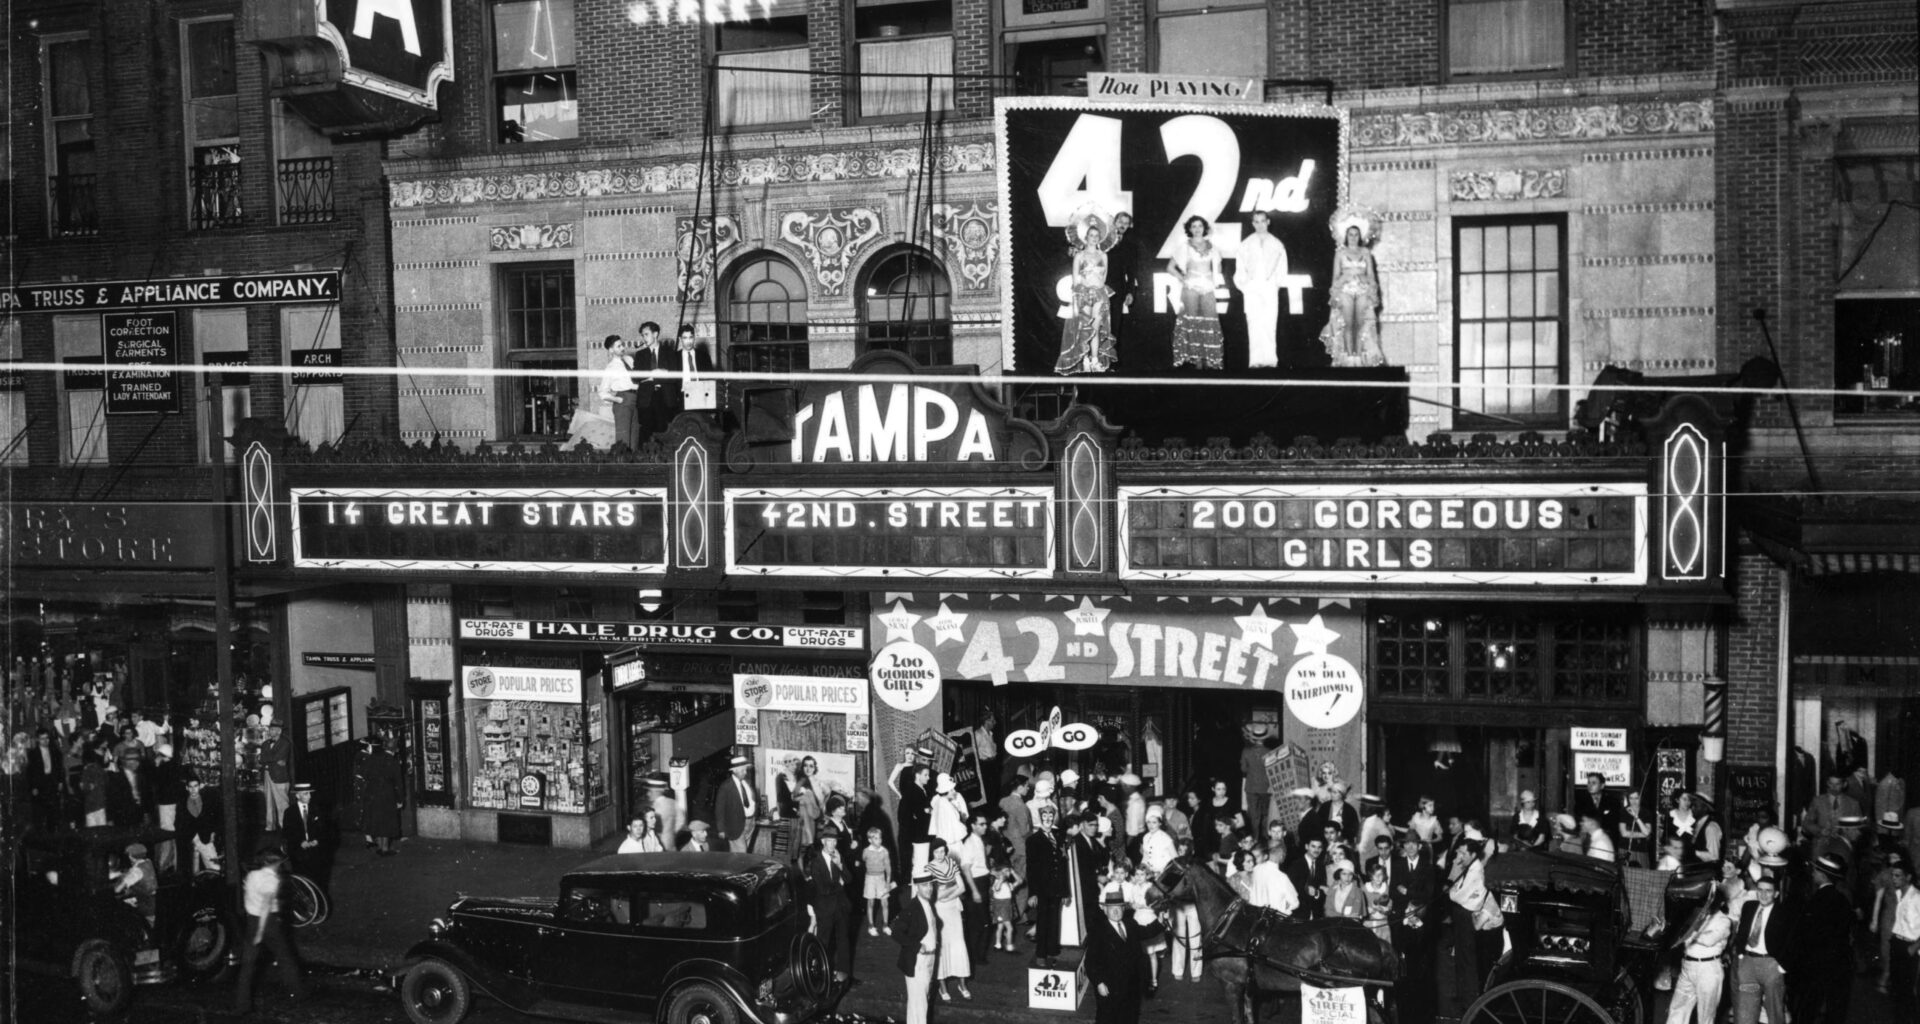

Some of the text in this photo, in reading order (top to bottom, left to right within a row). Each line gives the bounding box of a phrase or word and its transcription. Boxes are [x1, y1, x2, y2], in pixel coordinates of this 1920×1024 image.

[30, 288, 86, 308] TRUSS
[120, 282, 221, 304] APPLIANCE
[126, 318, 153, 327] FOOT
[110, 326, 170, 337] CORRECTION
[117, 339, 162, 349] SURGICAL
[115, 348, 167, 358] GARMENTS
[303, 353, 332, 365] ARCH
[111, 369, 171, 380] EXAMINATION
[120, 382, 162, 393] TRAINED
[112, 392, 130, 401] LADY
[326, 501, 635, 527] 14 GREAT STARS
[1192, 500, 1564, 530] 200 GORGEOUS
[1283, 538, 1434, 568] GIRLS
[464, 620, 525, 630] CUT-RATE
[535, 621, 781, 641] HALE DRUG CO.
[474, 628, 515, 638] DRUGS
[787, 628, 857, 639] CUT-RATE
[669, 636, 713, 645] OWNER
[799, 636, 847, 647] DRUGS
[305, 655, 322, 663] TAMPA
[323, 655, 340, 663] TRUSS
[889, 653, 924, 669] 200
[1108, 621, 1279, 690] STREET
[738, 662, 777, 676] CANDY
[811, 665, 862, 679] KODAKS
[1322, 669, 1347, 679] DEAL
[469, 675, 493, 689] STORE
[499, 675, 575, 694] POPULAR PRICES
[743, 684, 769, 699] STORE
[775, 684, 858, 704] POPULAR PRICES
[1062, 729, 1087, 743] GO
[1599, 731, 1623, 740] SUNDAY
[1012, 735, 1037, 750] GO
[1578, 738, 1604, 748] APRIL
[1735, 774, 1768, 789] MAAS
[1034, 986, 1068, 999] STREET
[1309, 998, 1357, 1012] STREET
[1312, 1008, 1357, 1019] SPECIAL
